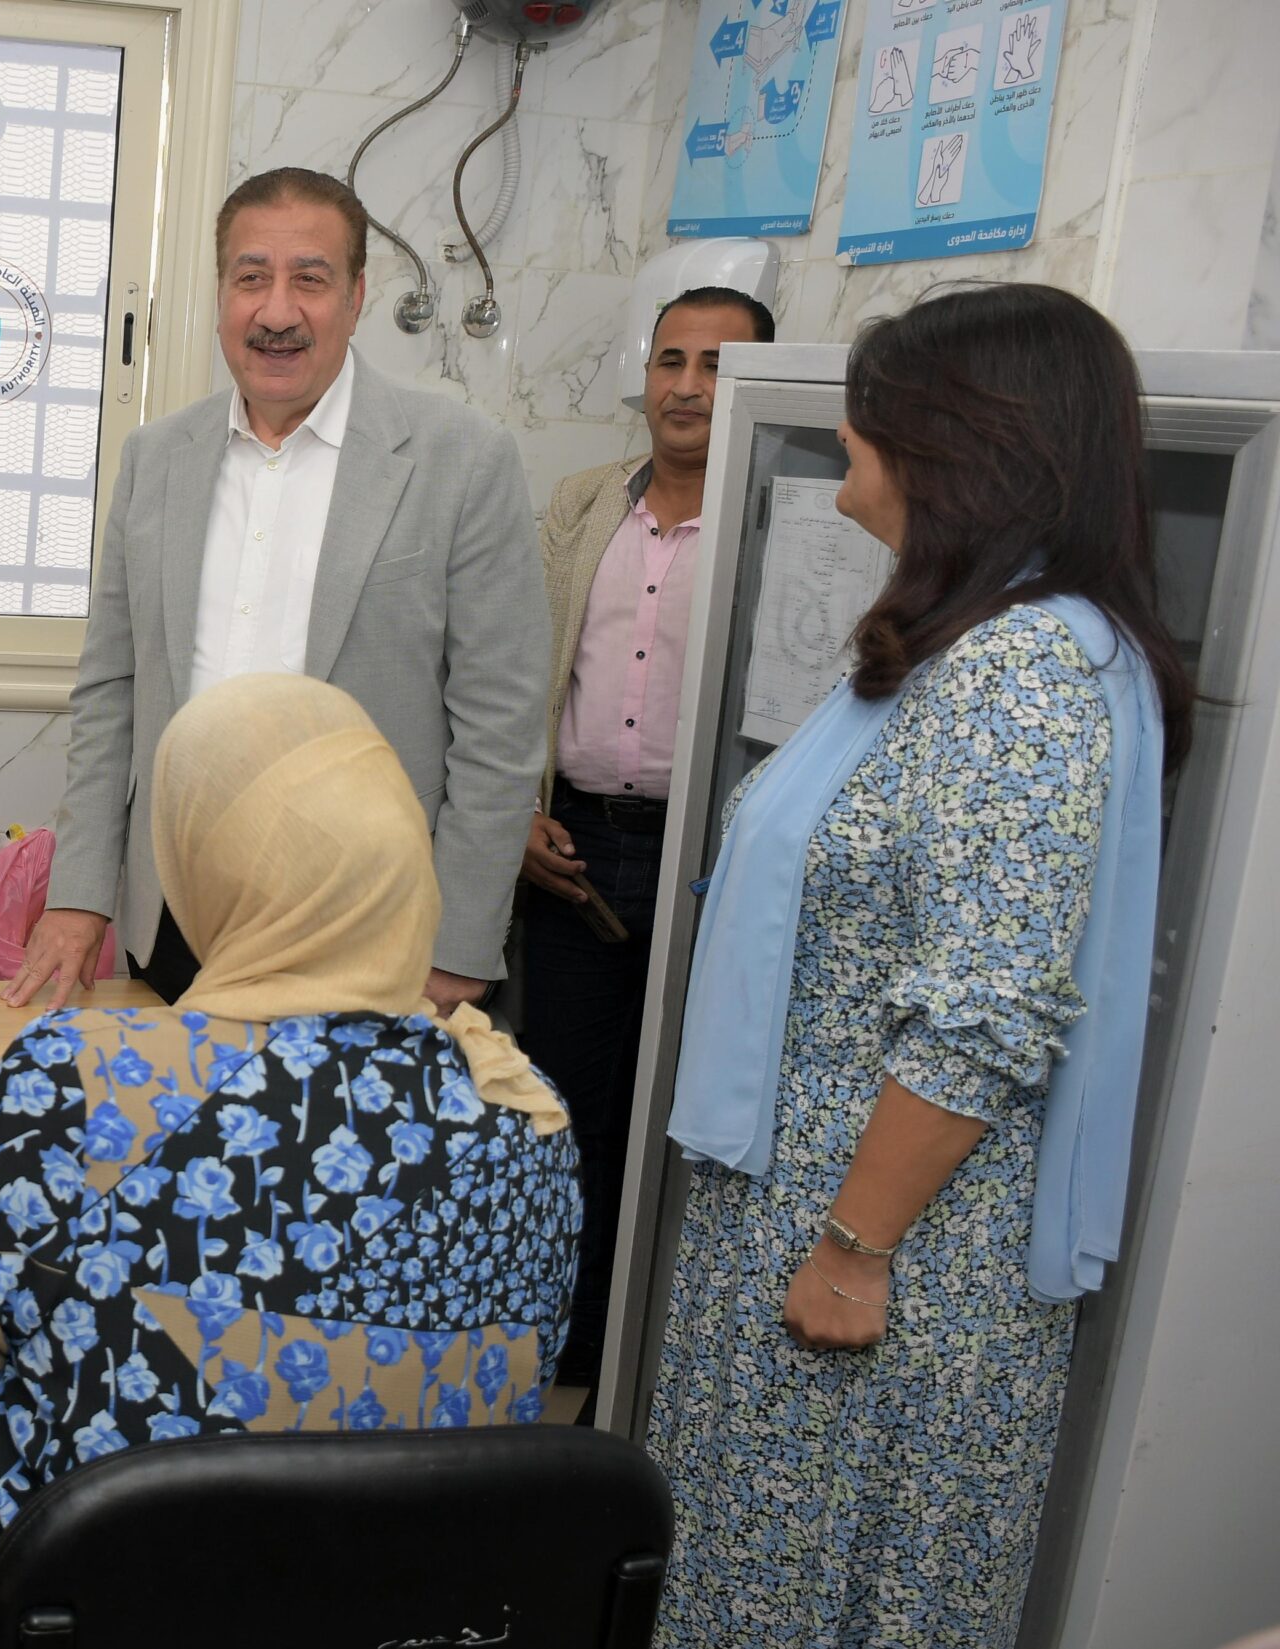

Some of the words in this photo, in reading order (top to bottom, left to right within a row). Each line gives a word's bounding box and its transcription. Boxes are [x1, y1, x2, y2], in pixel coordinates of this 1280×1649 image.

[735, 27, 744, 49] 4
[716, 129, 725, 151] 5
[947, 230, 977, 247] العدوى
[977, 227, 1007, 241] مكافحة
[1008, 224, 1027, 240] إدارة
[20, 285, 45, 326] الهيئة
[1, 343, 41, 395] AUTHORITY
